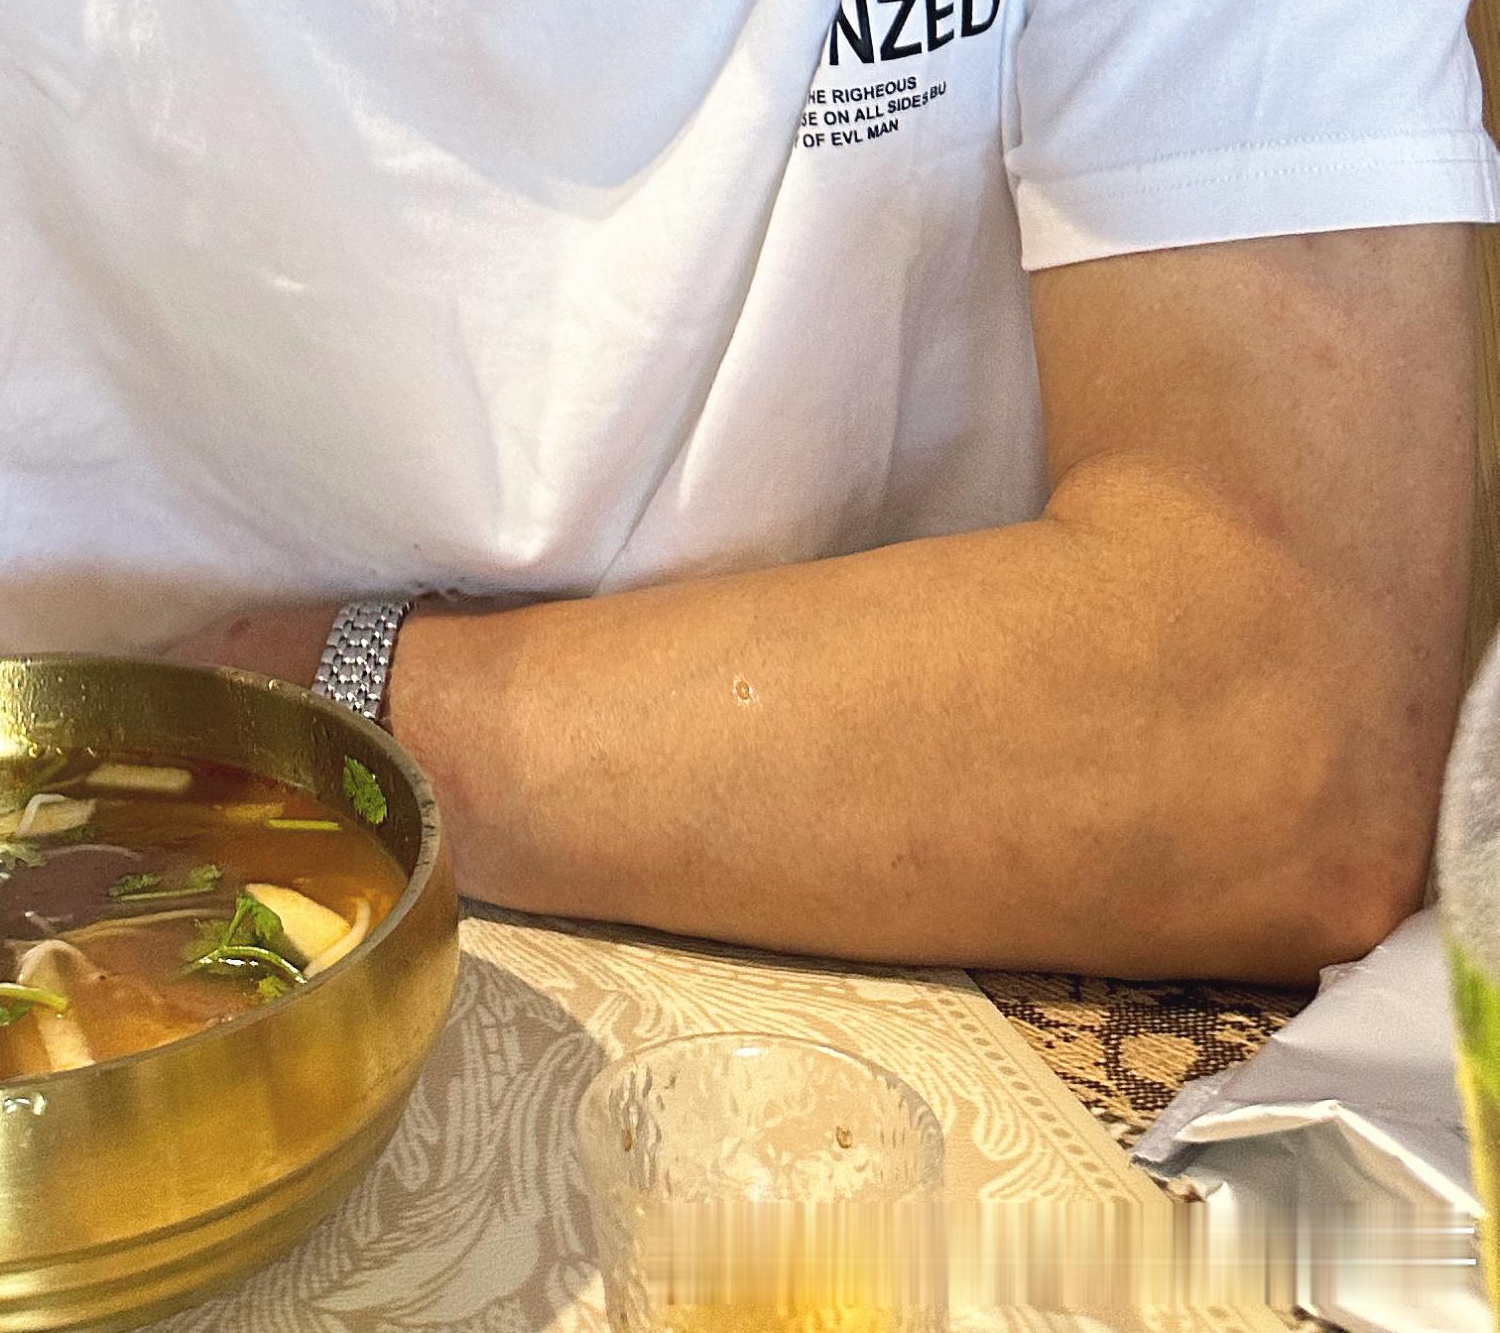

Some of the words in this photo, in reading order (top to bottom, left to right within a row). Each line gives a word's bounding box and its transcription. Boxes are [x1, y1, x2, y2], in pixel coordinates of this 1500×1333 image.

[832, 76, 917, 104] RIGHEOUS
[824, 109, 849, 125] ON
[854, 104, 885, 122] ALL
[803, 133, 825, 148] OF
[831, 129, 863, 146] EVL
[867, 118, 899, 140] MAN
